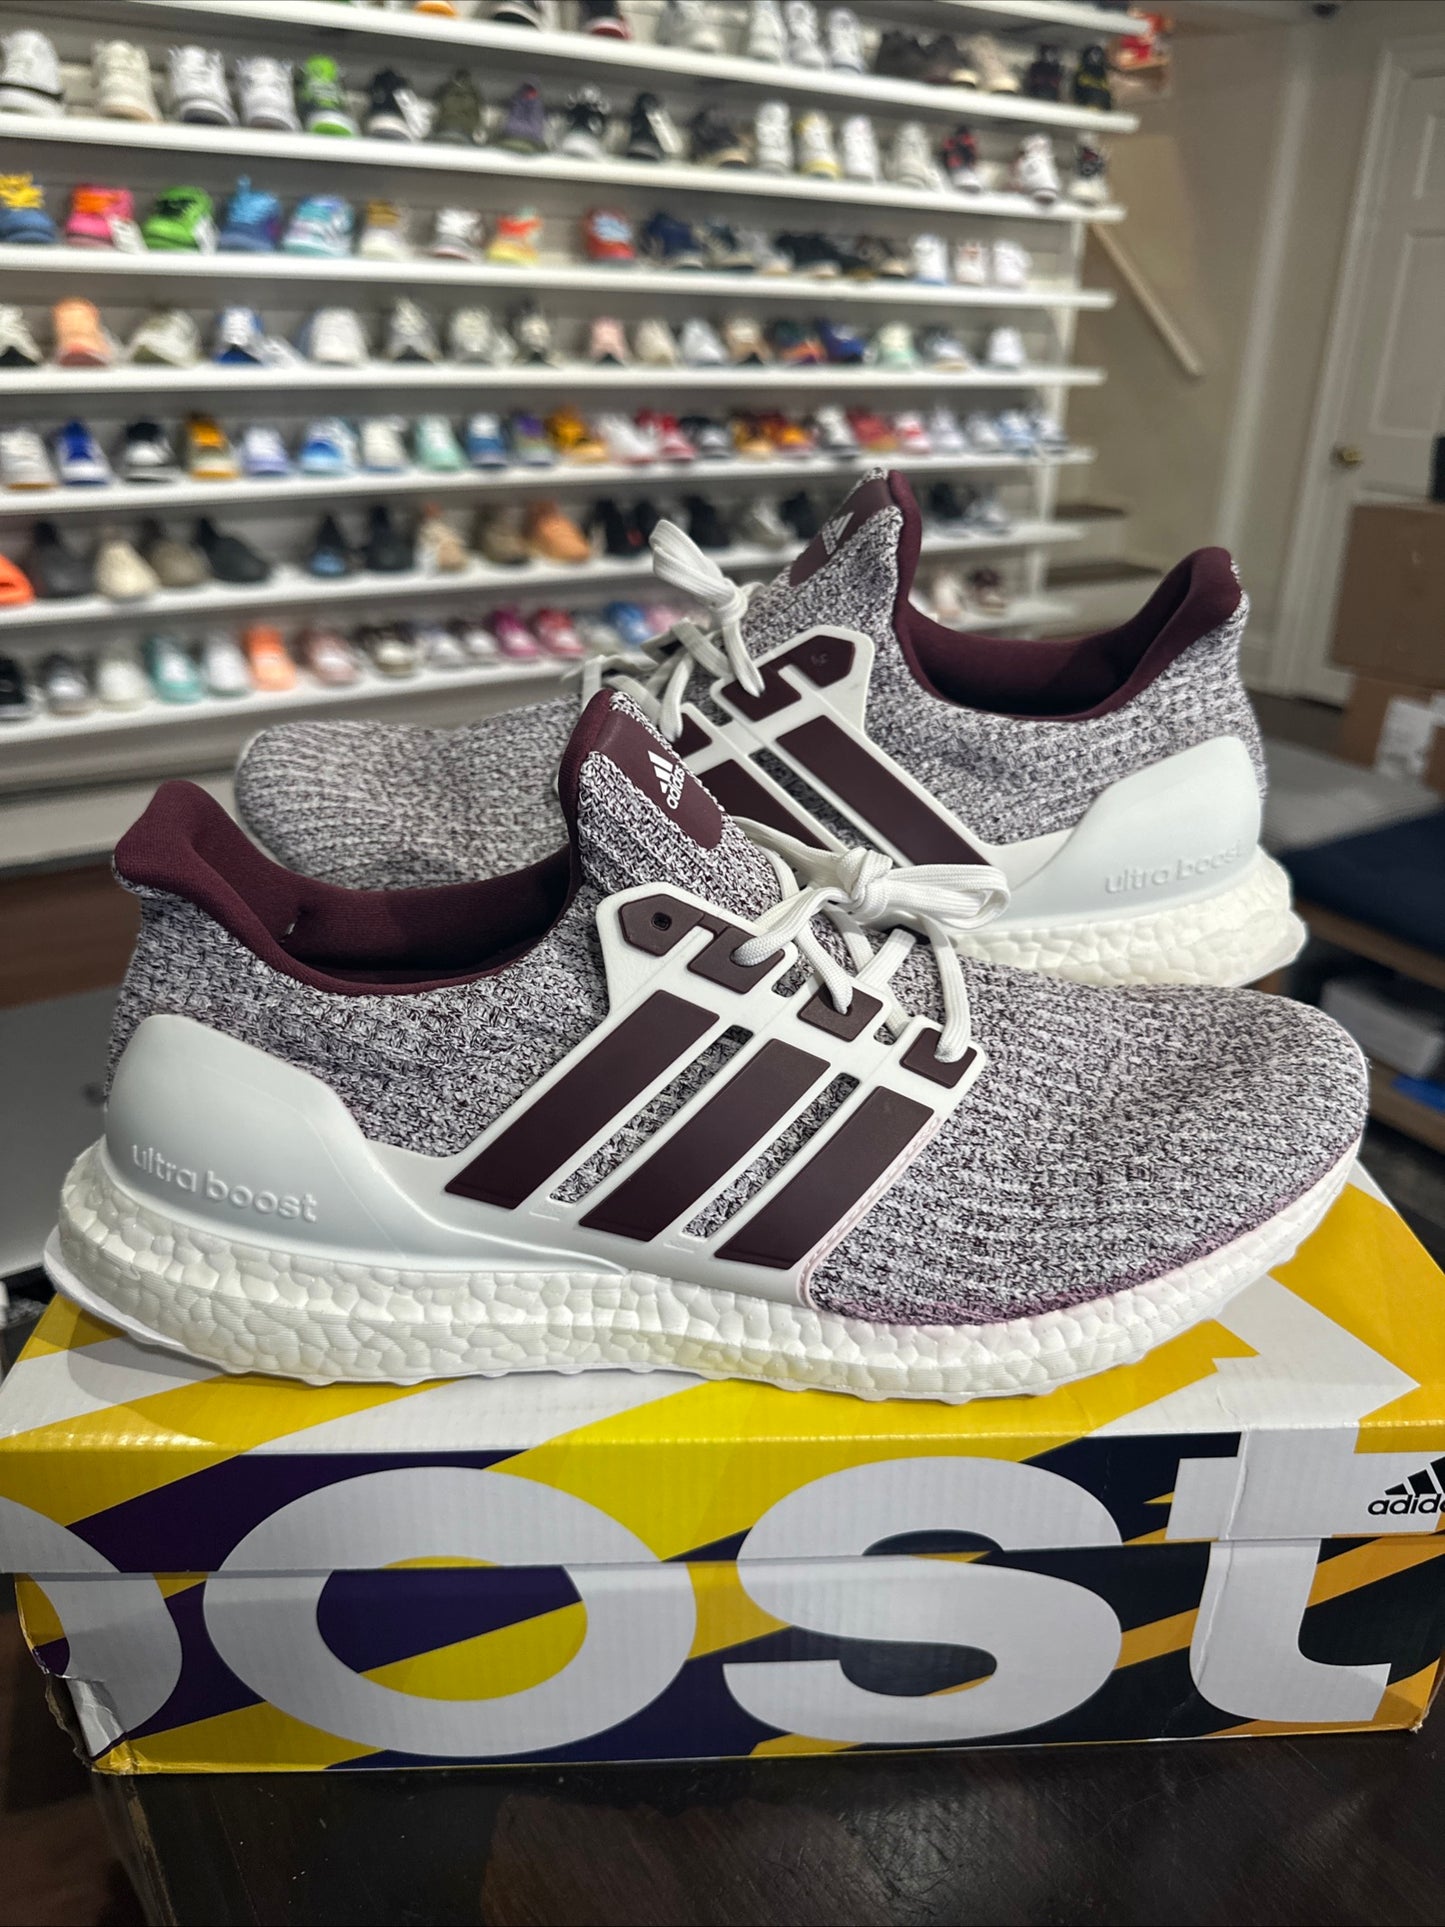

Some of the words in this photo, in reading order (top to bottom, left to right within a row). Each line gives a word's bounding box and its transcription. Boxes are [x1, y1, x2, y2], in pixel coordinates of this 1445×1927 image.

[666, 764, 685, 809] adidas
[1105, 869, 1168, 893] ultra
[132, 1144, 197, 1192] ultra
[206, 1170, 317, 1222] boost
[1367, 1494, 1445, 1515] adid
